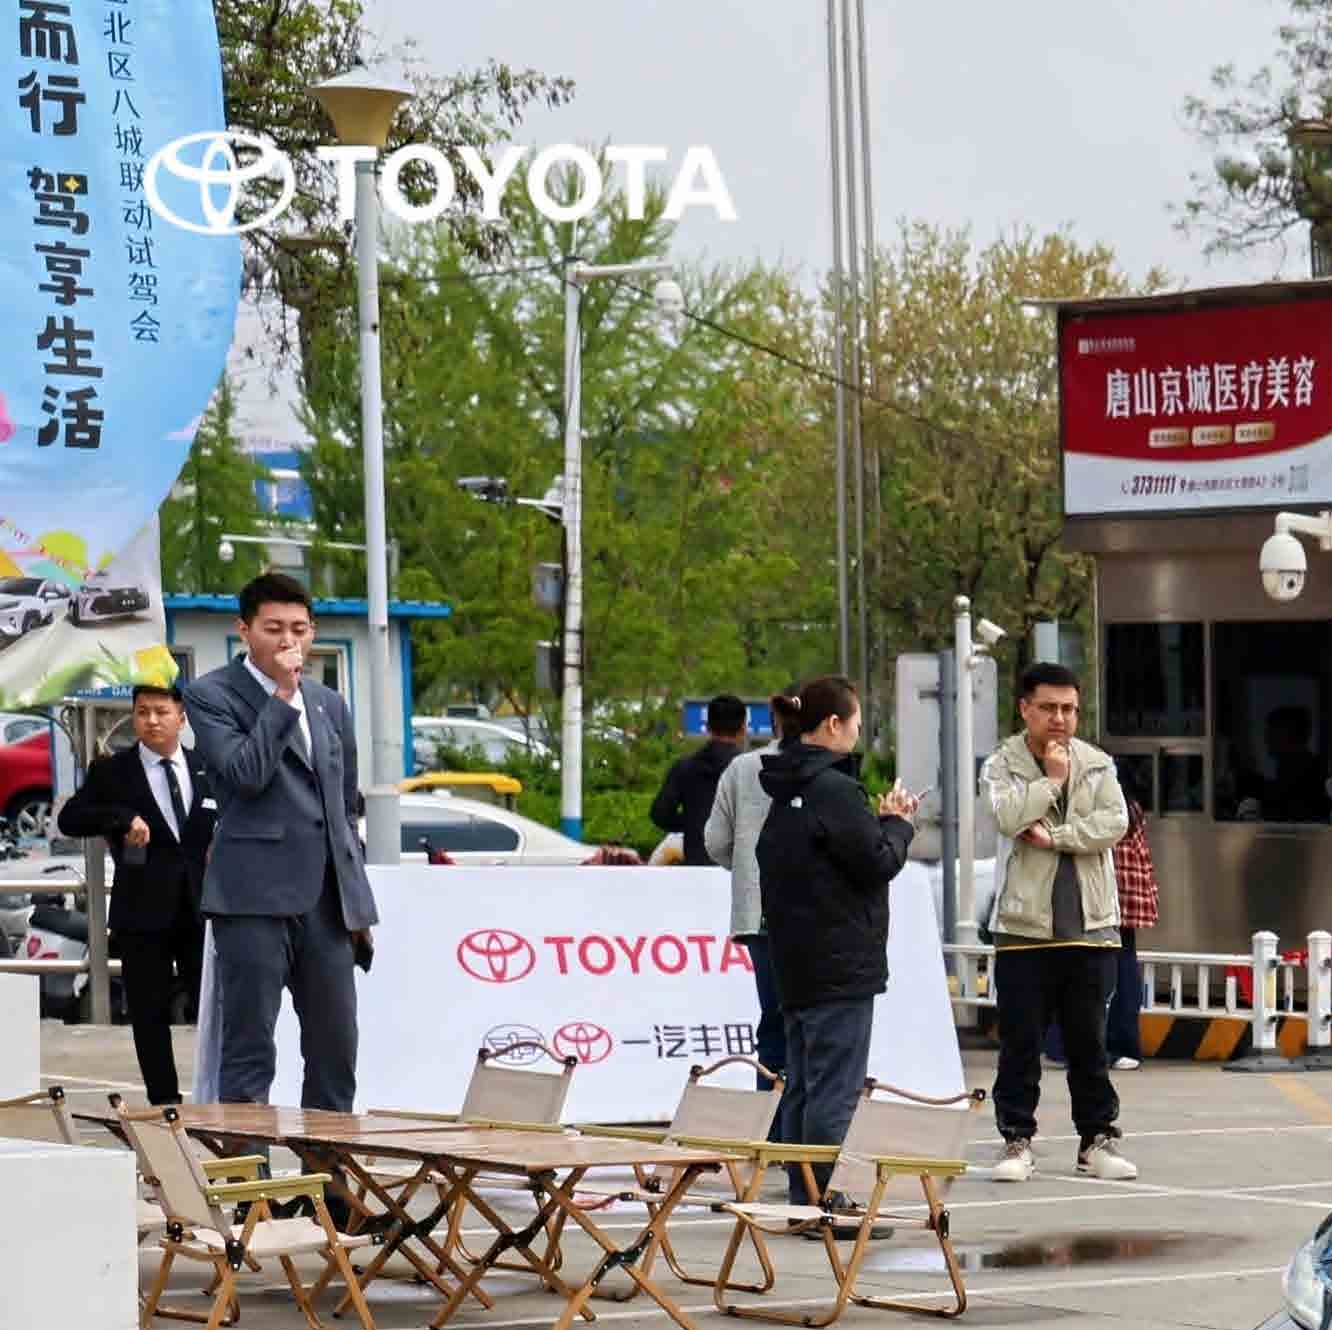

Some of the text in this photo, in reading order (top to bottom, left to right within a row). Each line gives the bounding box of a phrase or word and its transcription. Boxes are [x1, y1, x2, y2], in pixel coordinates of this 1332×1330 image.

[18, 0, 87, 136] 而行
[102, 0, 161, 344] 北区八城联动试驾会
[1105, 355, 1316, 419] 唐山京城医疗美容
[543, 934, 756, 976] TOYOTA
[620, 1024, 758, 1059] 一汽丰田
